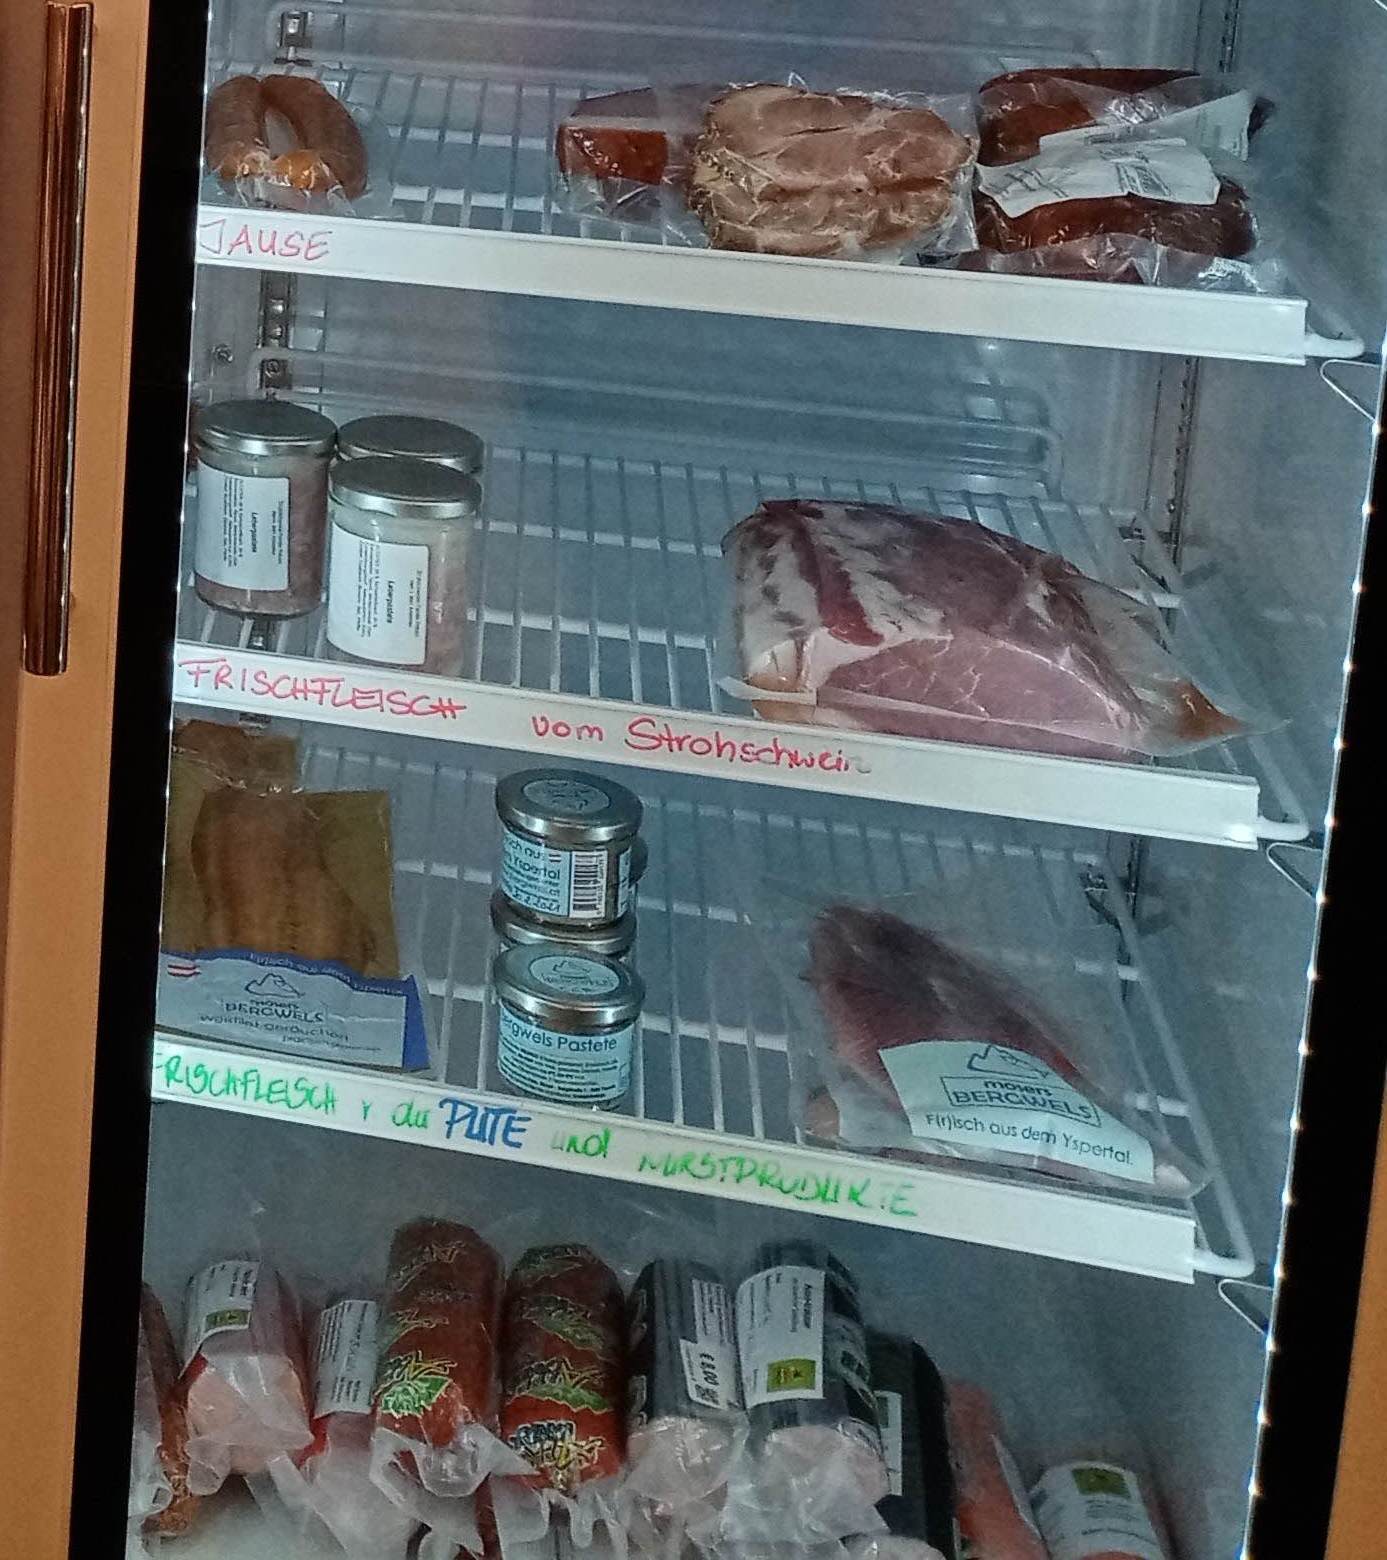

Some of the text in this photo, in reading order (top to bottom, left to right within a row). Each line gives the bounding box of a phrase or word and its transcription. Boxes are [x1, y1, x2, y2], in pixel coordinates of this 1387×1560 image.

[199, 218, 334, 261] JAUSE
[531, 716, 604, 743] vom
[225, 1001, 325, 1024] BERGWELS
[557, 1035, 618, 1053] Pastete
[983, 1079, 1053, 1097] mosers
[952, 1090, 1094, 1120] BERGWELS
[439, 1096, 533, 1149] PUTE
[989, 1121, 1018, 1137] aus
[1020, 1127, 1057, 1145] dem
